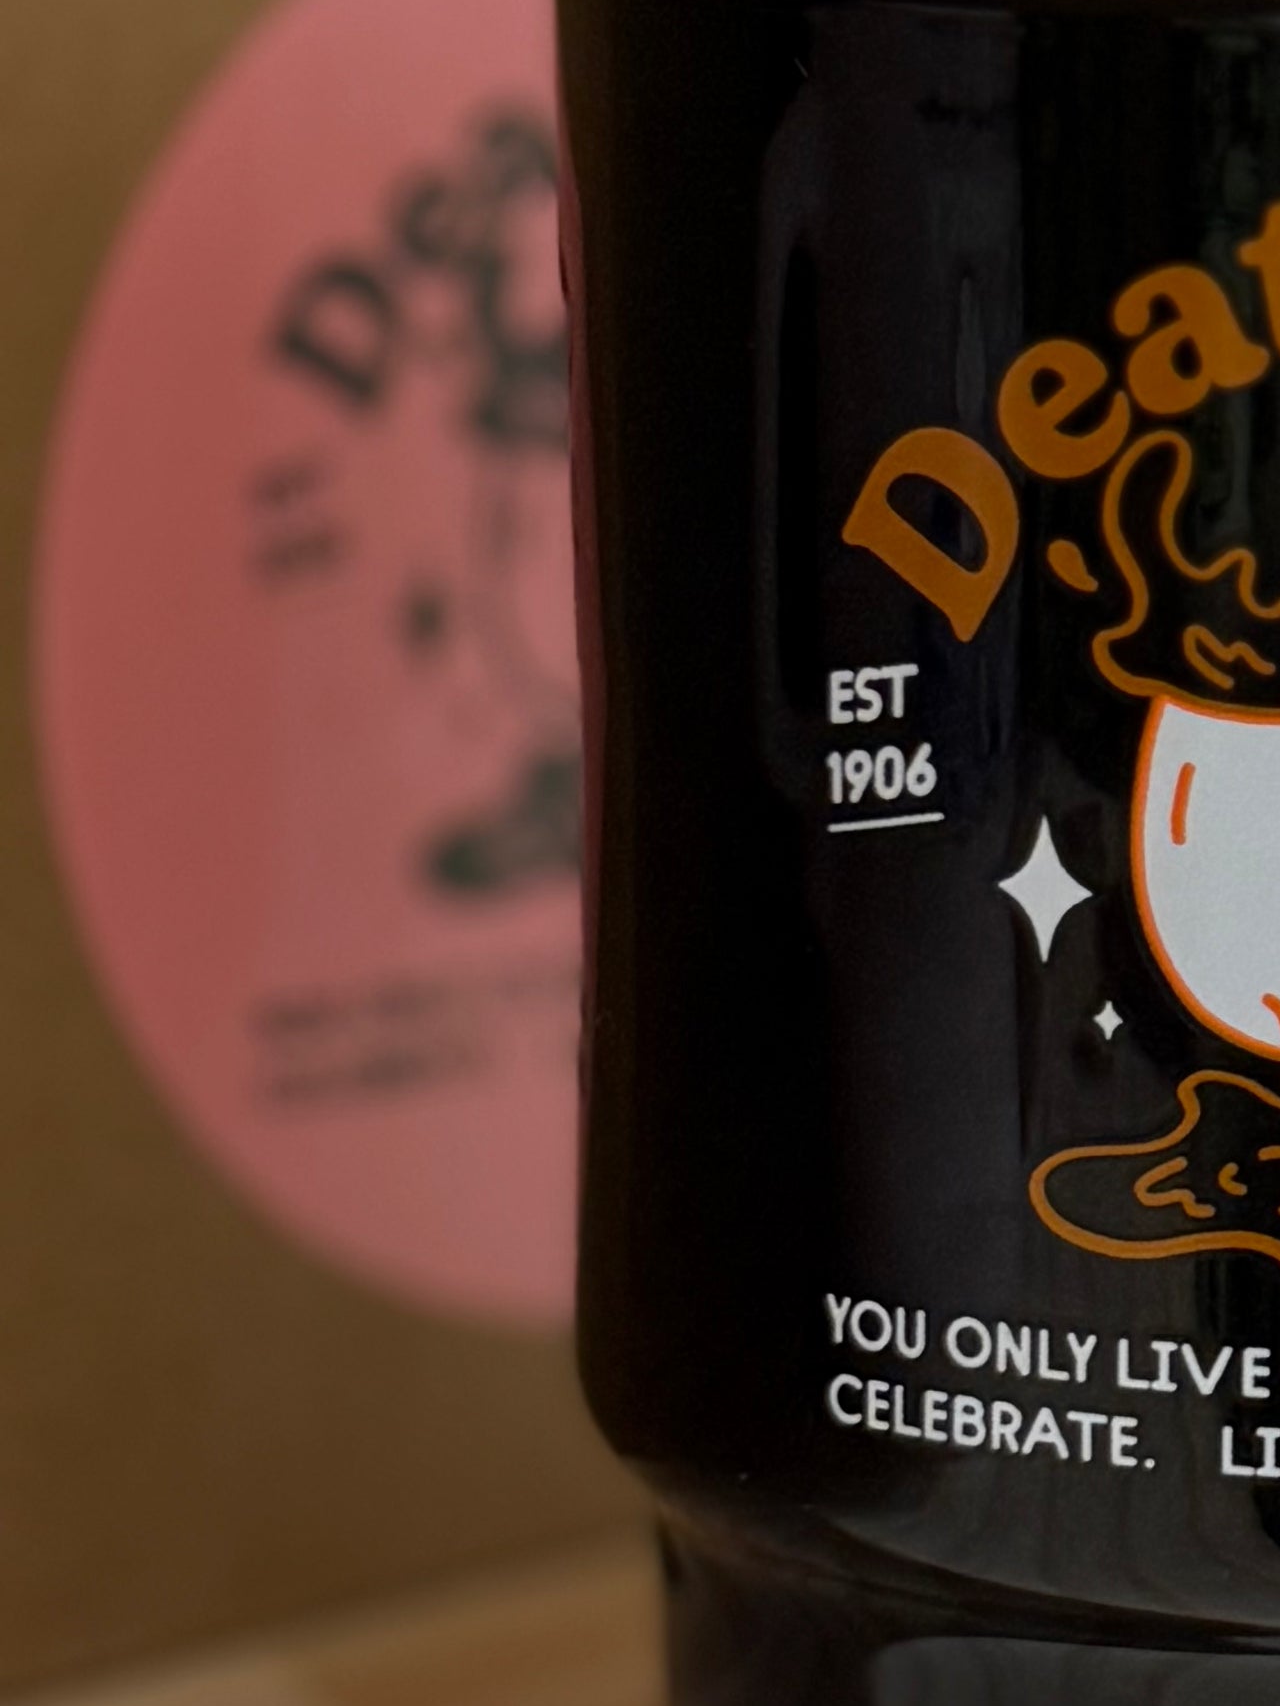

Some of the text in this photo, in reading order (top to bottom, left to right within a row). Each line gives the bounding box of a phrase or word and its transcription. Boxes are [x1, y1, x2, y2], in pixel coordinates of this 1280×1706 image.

[829, 663, 919, 724] EST
[827, 742, 938, 805] 1906
[826, 1292, 927, 1360] YOU
[945, 1315, 1098, 1384] ONLY
[1116, 1337, 1272, 1399] LIVE
[828, 1372, 1156, 1470] CELEBRATE.
